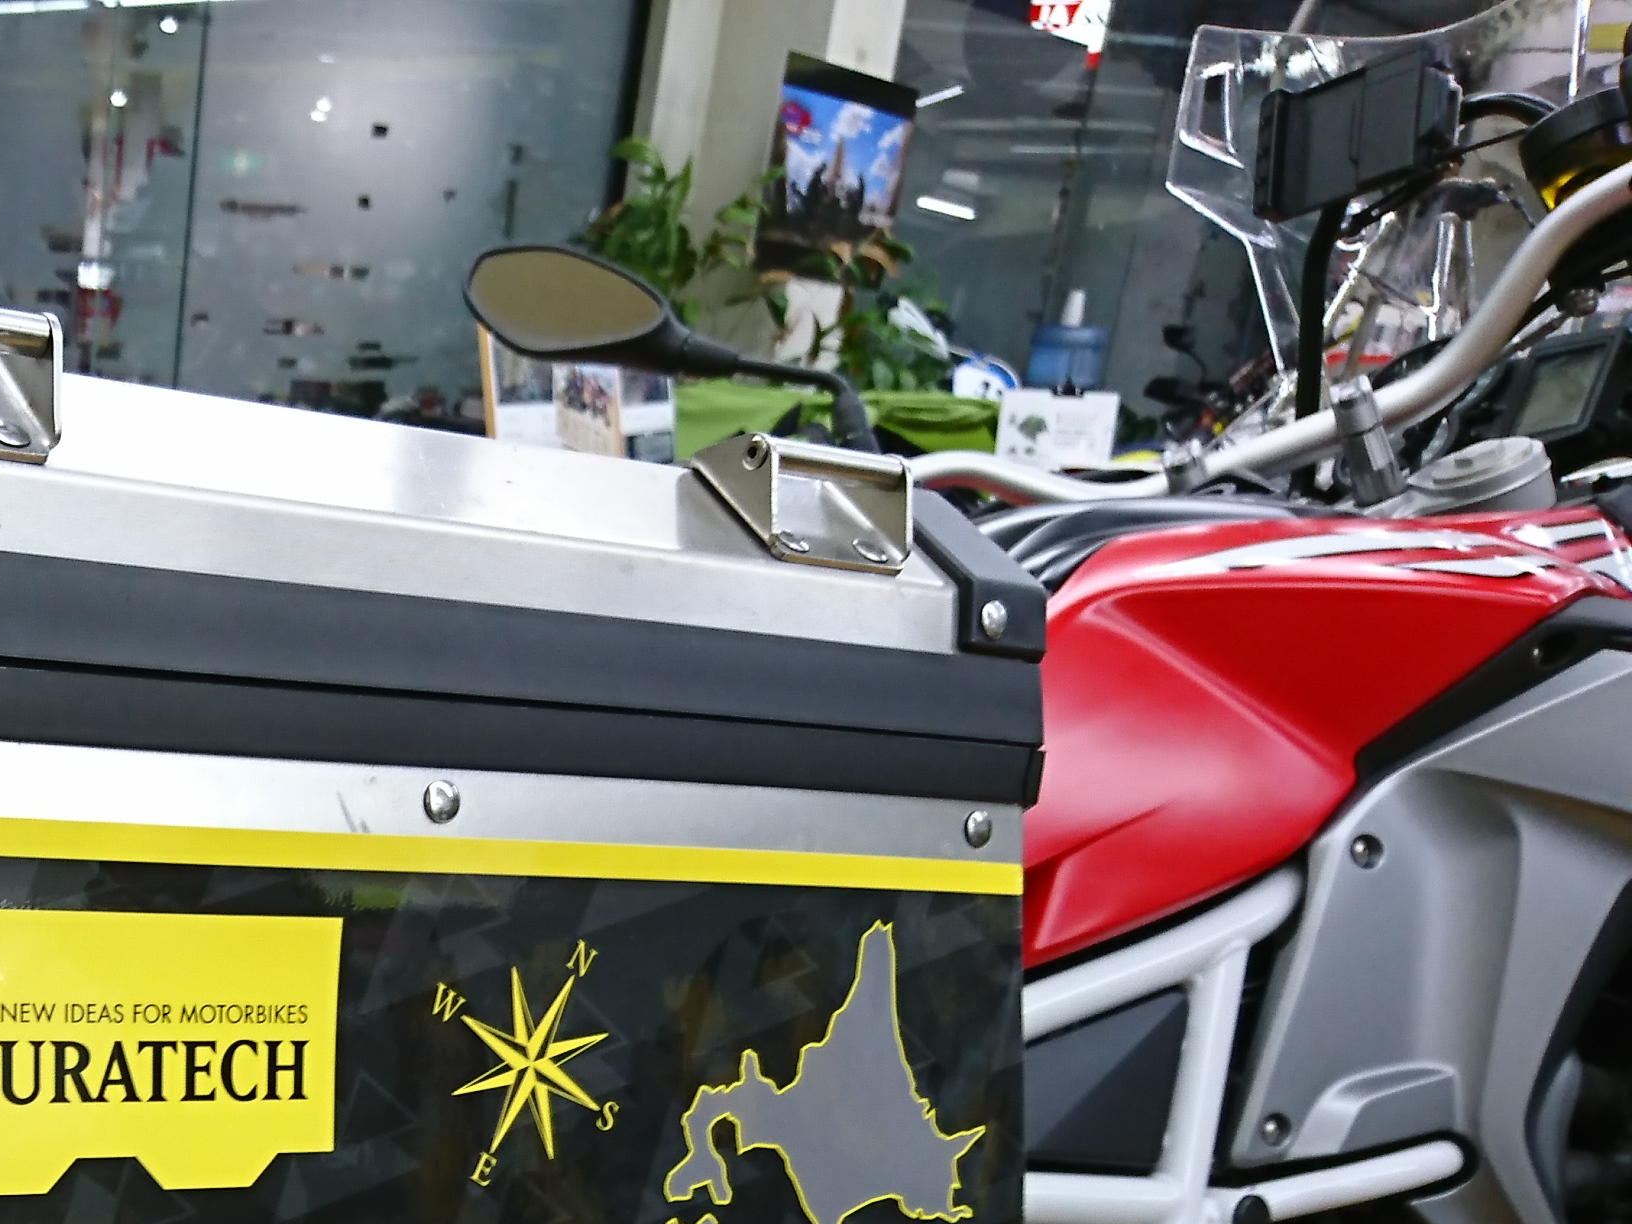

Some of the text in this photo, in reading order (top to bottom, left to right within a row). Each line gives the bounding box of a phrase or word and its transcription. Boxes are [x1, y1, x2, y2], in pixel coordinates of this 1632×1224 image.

[566, 938, 598, 978] N
[0, 1002, 309, 1025] NEW IDEAS FOR MOTORBIKES
[431, 981, 466, 1022] W
[595, 1101, 619, 1131] S
[469, 1151, 498, 1187] E
